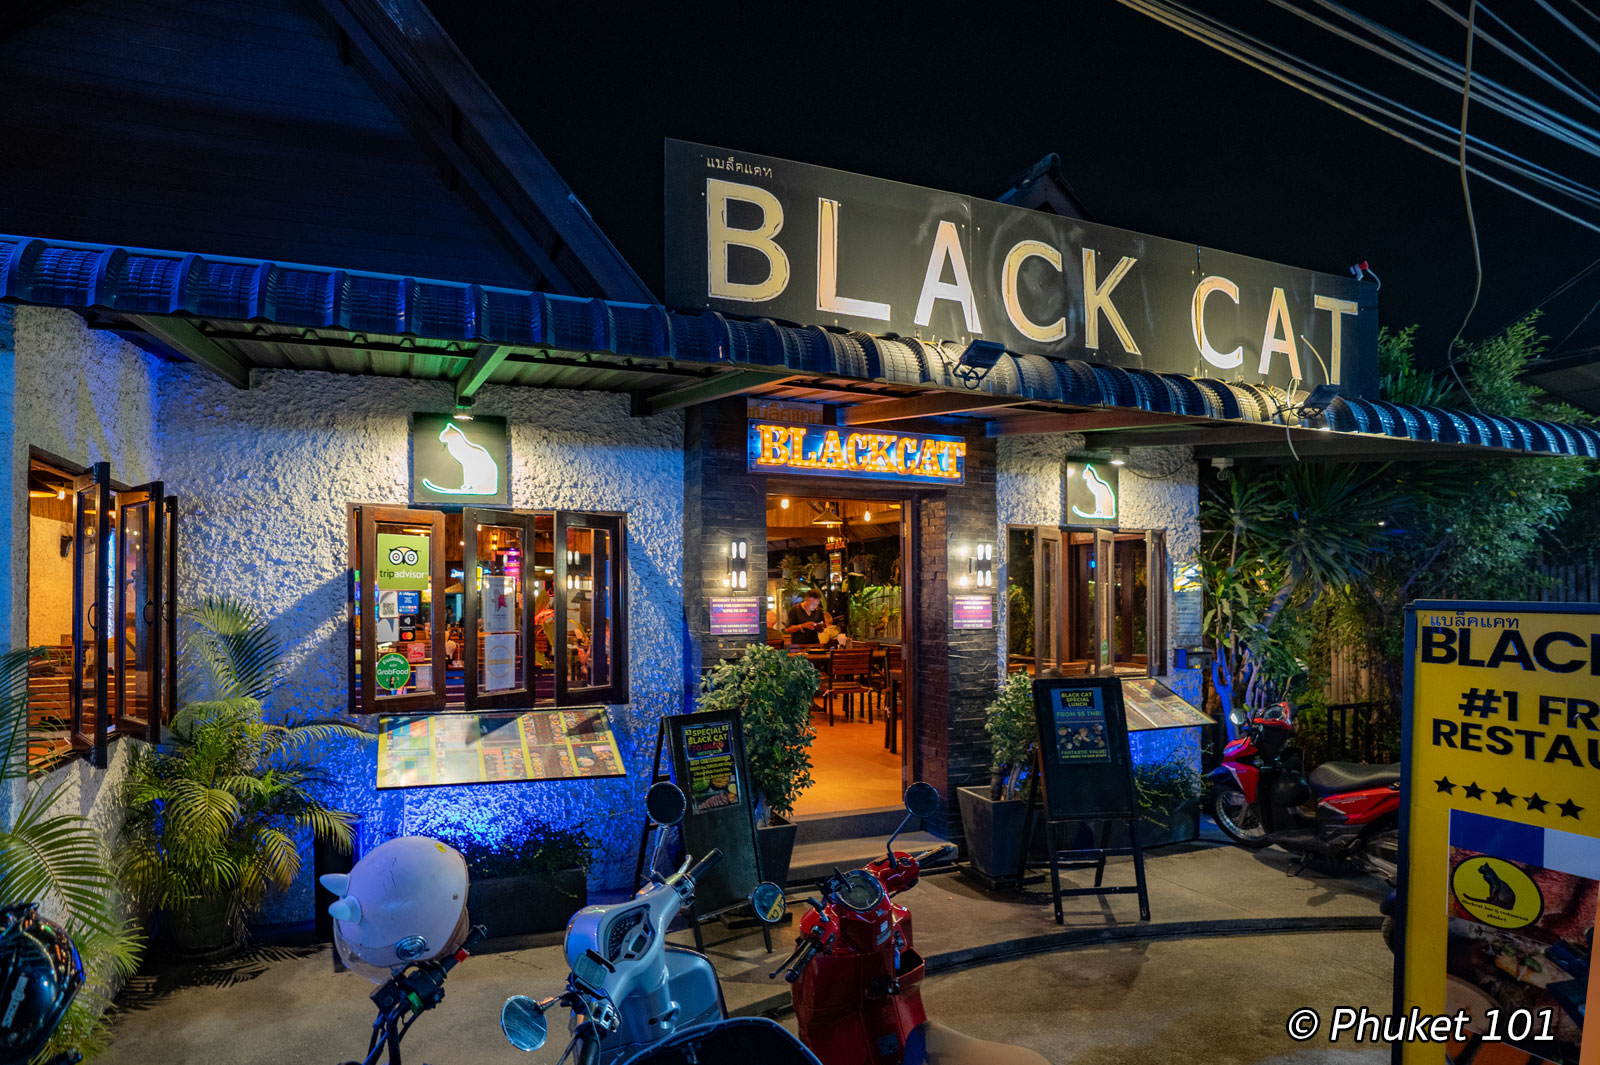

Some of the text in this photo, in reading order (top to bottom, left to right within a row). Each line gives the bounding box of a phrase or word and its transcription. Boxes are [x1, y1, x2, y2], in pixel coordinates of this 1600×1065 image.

[706, 156, 773, 179] แบล็คแคท
[706, 177, 1358, 385] BLACK CAT
[757, 425, 966, 479] BLACKCAT
[379, 569, 425, 580] tripadvisor
[1430, 611, 1519, 629] แบล็คแคท
[1421, 626, 1600, 676] BLAC
[376, 668, 409, 676] GrabFood
[1458, 687, 1519, 722] #1
[688, 733, 727, 744] BLACK CAT
[692, 727, 722, 736] SPECIAL
